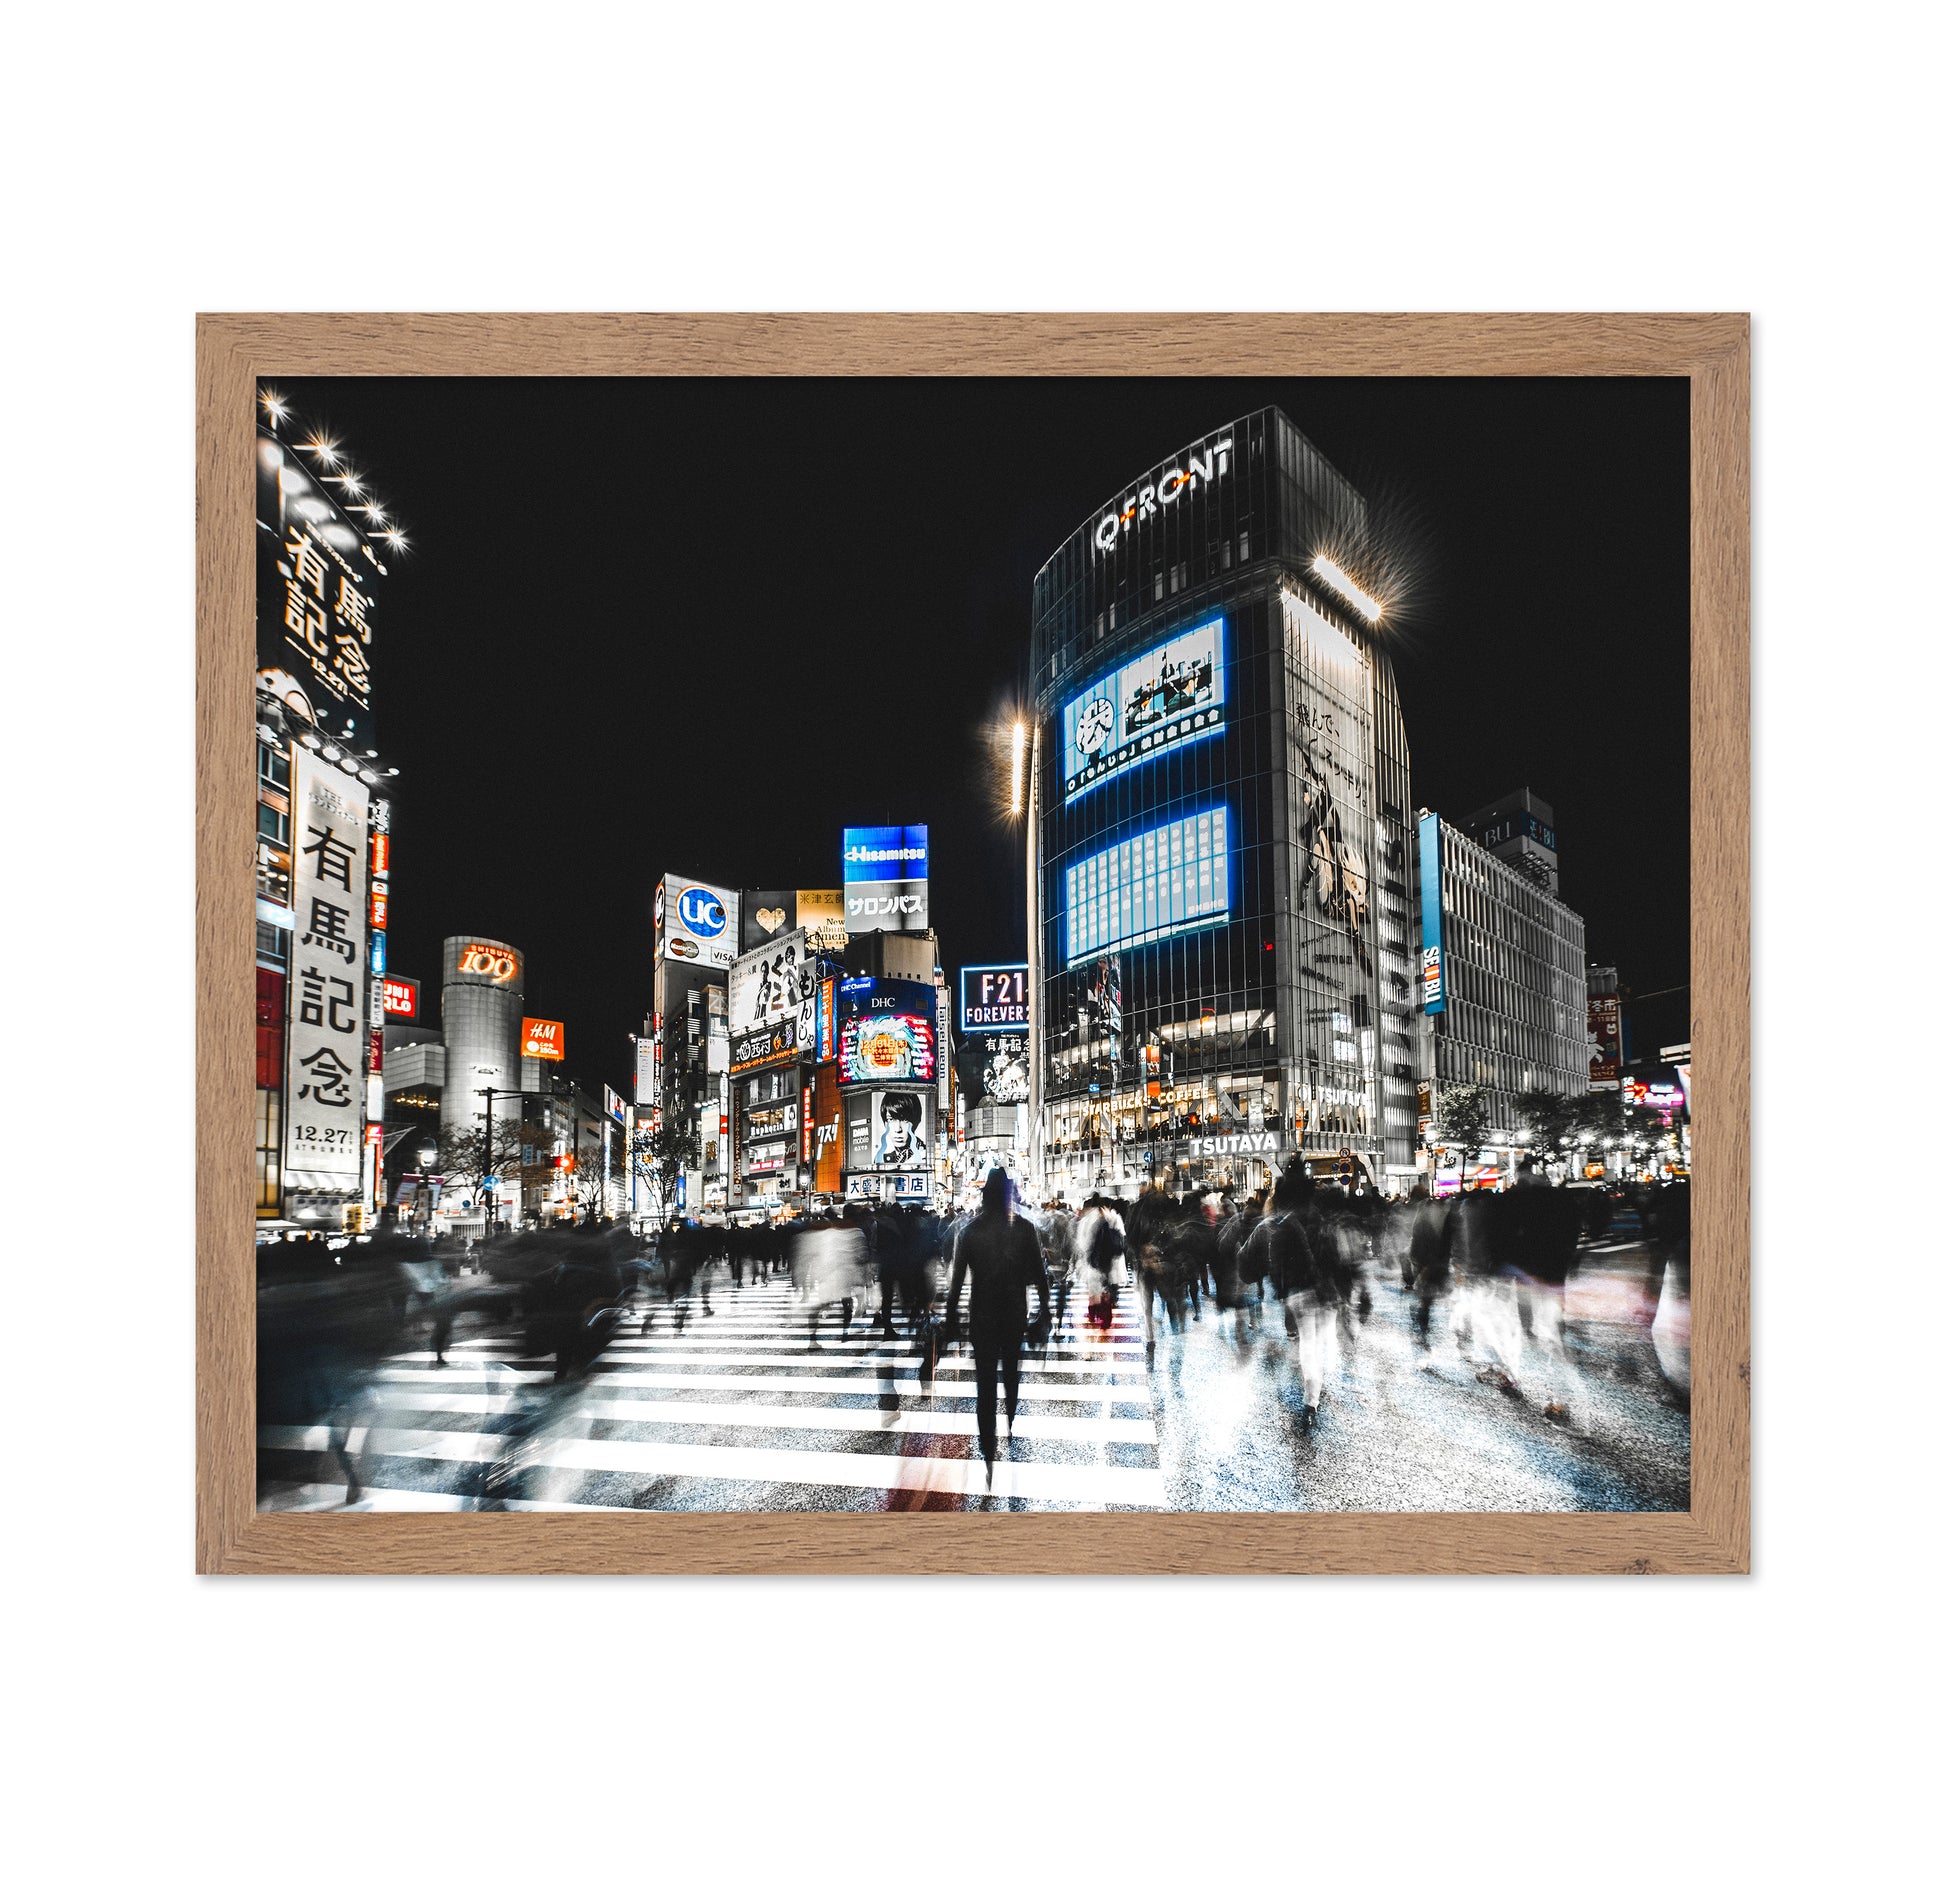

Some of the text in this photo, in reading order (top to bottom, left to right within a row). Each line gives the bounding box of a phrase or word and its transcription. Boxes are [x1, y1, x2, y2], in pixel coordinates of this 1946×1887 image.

[1095, 438, 1232, 551] QFRONT
[844, 845, 926, 862] Hisamitsu
[682, 896, 725, 929] UC
[848, 895, 924, 917] サロンパス
[826, 918, 845, 926] New
[470, 945, 514, 960] SHIBUYA
[713, 951, 734, 962] VISA
[299, 825, 358, 1109] 有馬記念
[458, 951, 517, 983] 109
[1424, 945, 1441, 1004] SEIBU
[851, 982, 871, 990] Channel
[982, 972, 1023, 1004] F21
[799, 970, 815, 1047] もんじゃ
[871, 997, 896, 1008] DHC
[966, 1005, 1024, 1023] FOREVER
[530, 1023, 557, 1040] H&M
[1083, 1087, 1209, 1116] STARBUCKS COFFEE
[294, 1125, 349, 1145] 12.27
[816, 1111, 840, 1161] クスリ
[1191, 1133, 1278, 1155] TSUTAYA
